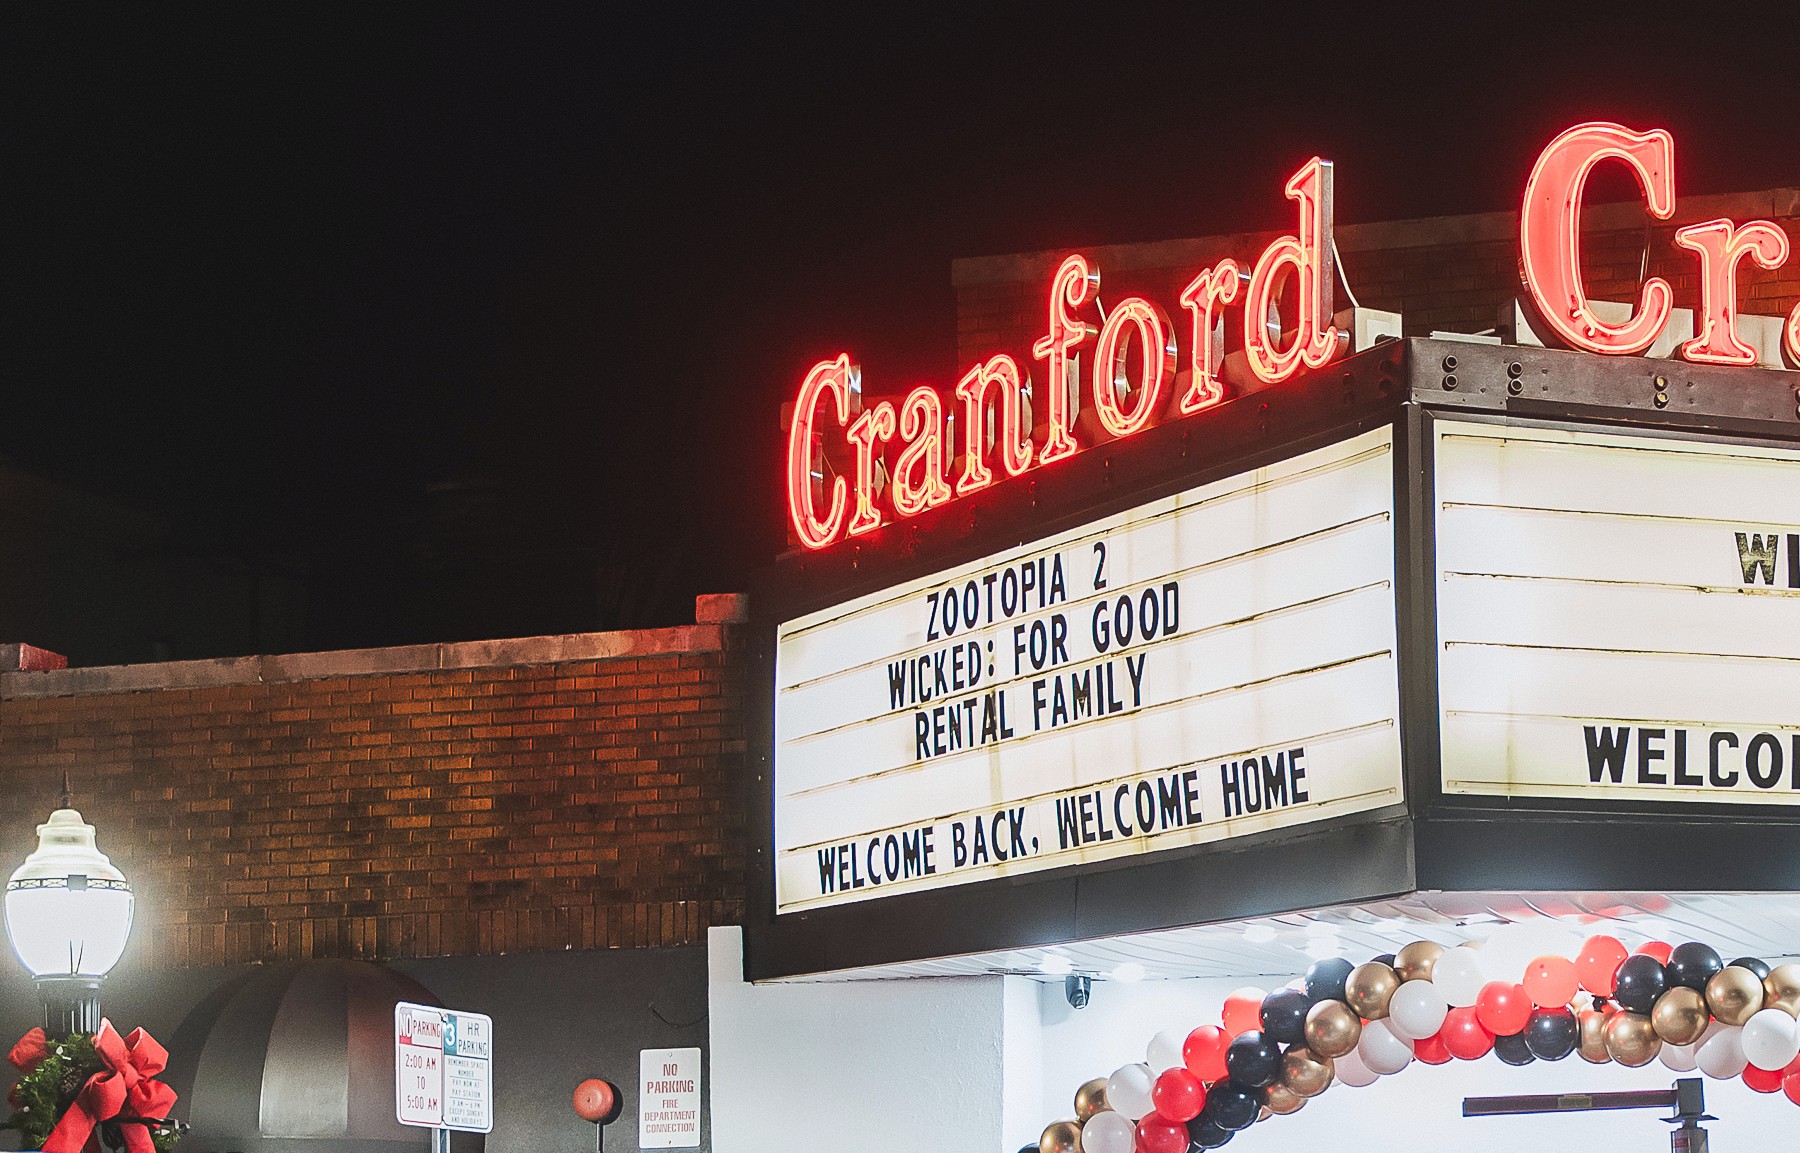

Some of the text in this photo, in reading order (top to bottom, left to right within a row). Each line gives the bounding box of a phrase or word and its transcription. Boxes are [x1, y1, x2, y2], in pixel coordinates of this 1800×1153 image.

[787, 155, 1346, 549] Cranford
[926, 541, 1107, 642] ZOOTOPIA 2
[1013, 613, 1069, 676] FOR
[1092, 581, 1180, 654] GOOD
[916, 652, 1148, 761] RENTAL FAMILY
[817, 747, 1311, 895] WELCOME BACK, WELCOME HOME
[400, 1013, 440, 1038] NO PARKING
[467, 1022, 480, 1036] HR
[445, 1023, 455, 1046] 3
[458, 1040, 487, 1056] PARKING
[405, 1054, 436, 1070] 2:00 AM
[470, 1061, 484, 1069] SPACE
[663, 1063, 678, 1077] NO
[417, 1076, 425, 1089] TO
[647, 1080, 694, 1093] PARKING
[407, 1095, 437, 1111] 5:00 AM
[662, 1099, 678, 1108] FIRE
[645, 1111, 695, 1121] DEPARTMENT
[646, 1123, 695, 1133] CONNECTION
